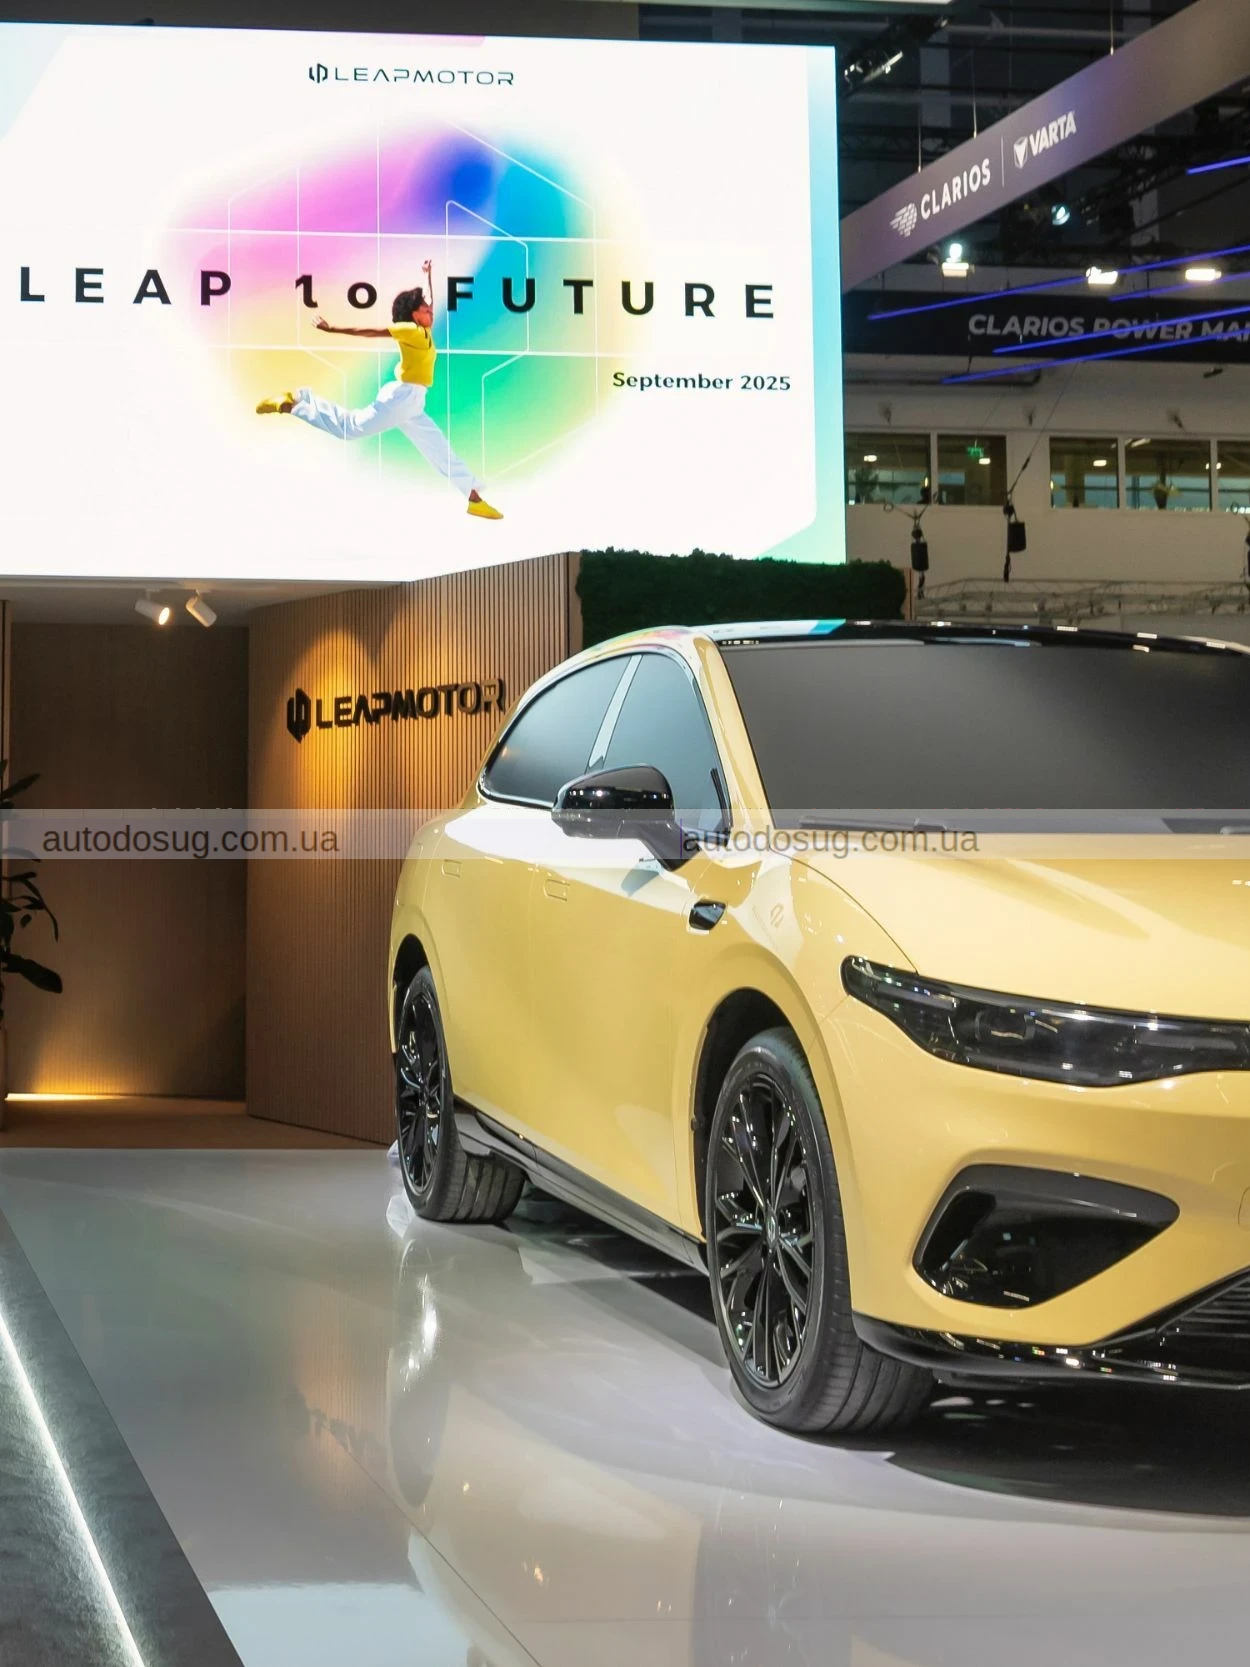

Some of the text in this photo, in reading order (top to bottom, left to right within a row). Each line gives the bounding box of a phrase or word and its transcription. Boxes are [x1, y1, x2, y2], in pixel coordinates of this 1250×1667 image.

[335, 67, 514, 86] LEAPMOTOR
[1029, 110, 1077, 157] VARTA
[920, 158, 991, 220] CLARIOS
[20, 266, 232, 306] LEAP
[447, 276, 774, 319] FUTURE
[968, 314, 1084, 337] CLARIOS
[1093, 318, 1194, 340] POWER
[612, 371, 791, 392] September 2025
[316, 678, 506, 730] LEAPMOTOR
